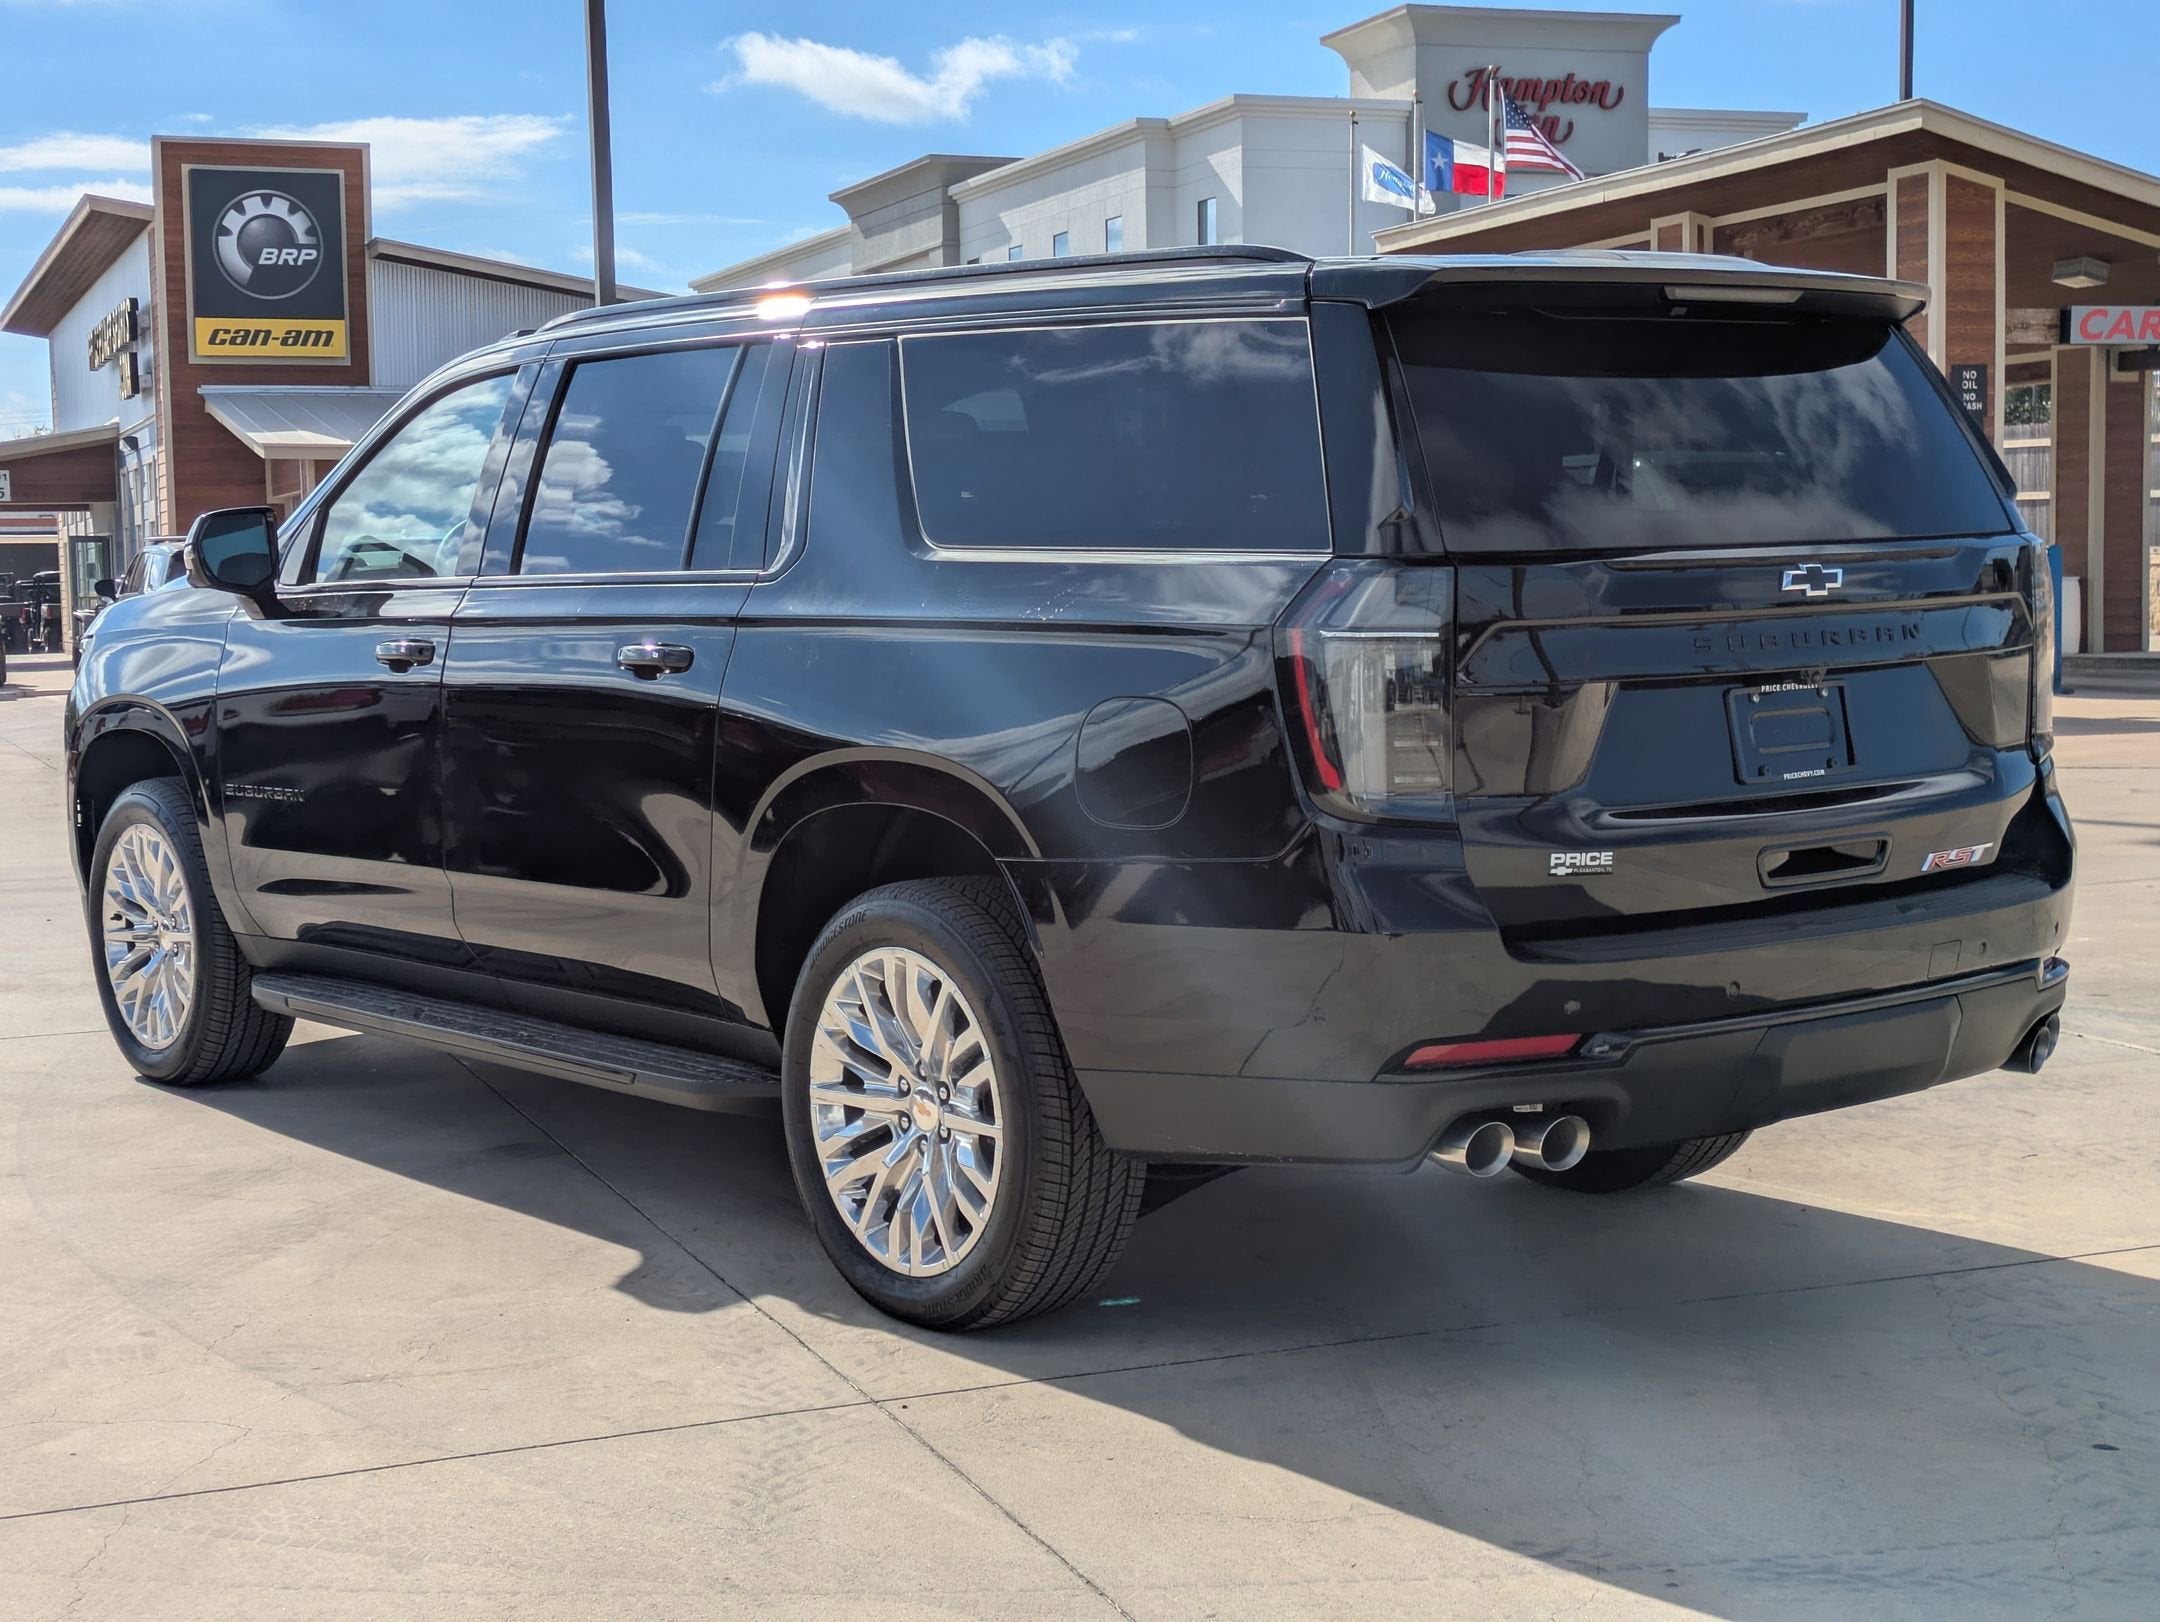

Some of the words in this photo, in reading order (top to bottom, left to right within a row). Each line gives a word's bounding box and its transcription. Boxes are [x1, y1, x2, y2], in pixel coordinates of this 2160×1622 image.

[1448, 64, 1625, 113] Hampton
[258, 248, 318, 266] BRP
[2079, 308, 2160, 340] CAR
[208, 328, 335, 347] can-am
[1962, 370, 1977, 380] NO
[1961, 380, 1978, 389] OIL
[1963, 393, 1976, 401] NO
[1963, 402, 1983, 410] ASH
[1693, 623, 1921, 651] SUBURBAN
[1761, 684, 1781, 693] PRICE
[225, 783, 304, 801] SUBURBAN
[1550, 851, 1614, 867] PRICE
[1921, 842, 1994, 871] RST
